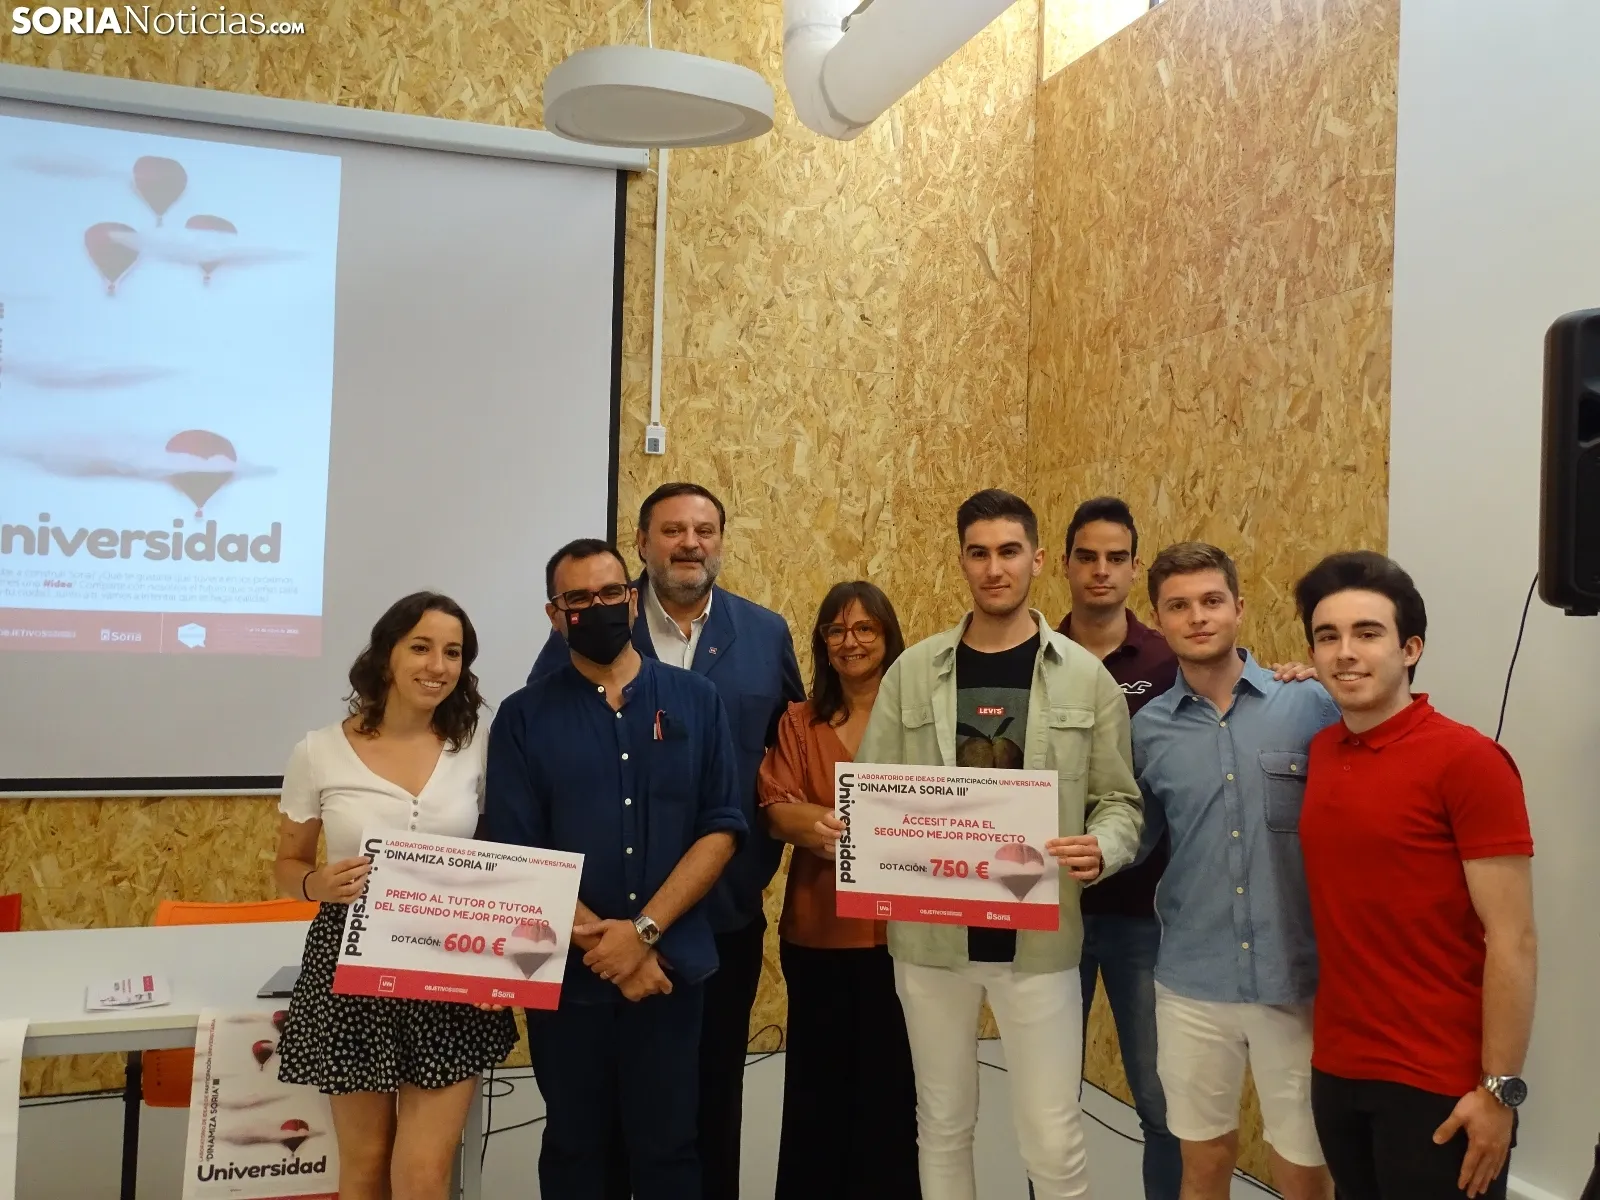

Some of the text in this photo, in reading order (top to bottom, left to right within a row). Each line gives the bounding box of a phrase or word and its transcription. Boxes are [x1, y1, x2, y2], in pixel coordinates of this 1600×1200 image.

[111, 631, 142, 642] Soria
[857, 773, 904, 782] LABORATORIO
[915, 775, 935, 783] IDEAS
[947, 776, 998, 786] PARTICIPACIÓN
[999, 779, 1052, 788] UNIVERSITARIA
[919, 785, 954, 796] SORIA
[838, 773, 857, 884] Universidad
[902, 813, 996, 830] ÁCCESIT PARA EL
[874, 827, 1026, 844] SEGUNDO MEJOR PROYECTO
[385, 840, 577, 869] LABORATORIO DE IDEAS DE PARTICIPACIÓN UNIVERSITARIA
[447, 857, 482, 870] SORIA
[879, 858, 990, 880] DOTACIÓN: 750 €
[386, 889, 543, 915] PREMIO AL TUTOR O TUTORA
[374, 901, 549, 928] DEL SEGUNDO MEJOR PROYECTO
[391, 933, 507, 956] DOTACIÓN: 600 €
[197, 1155, 327, 1182] Universidad
